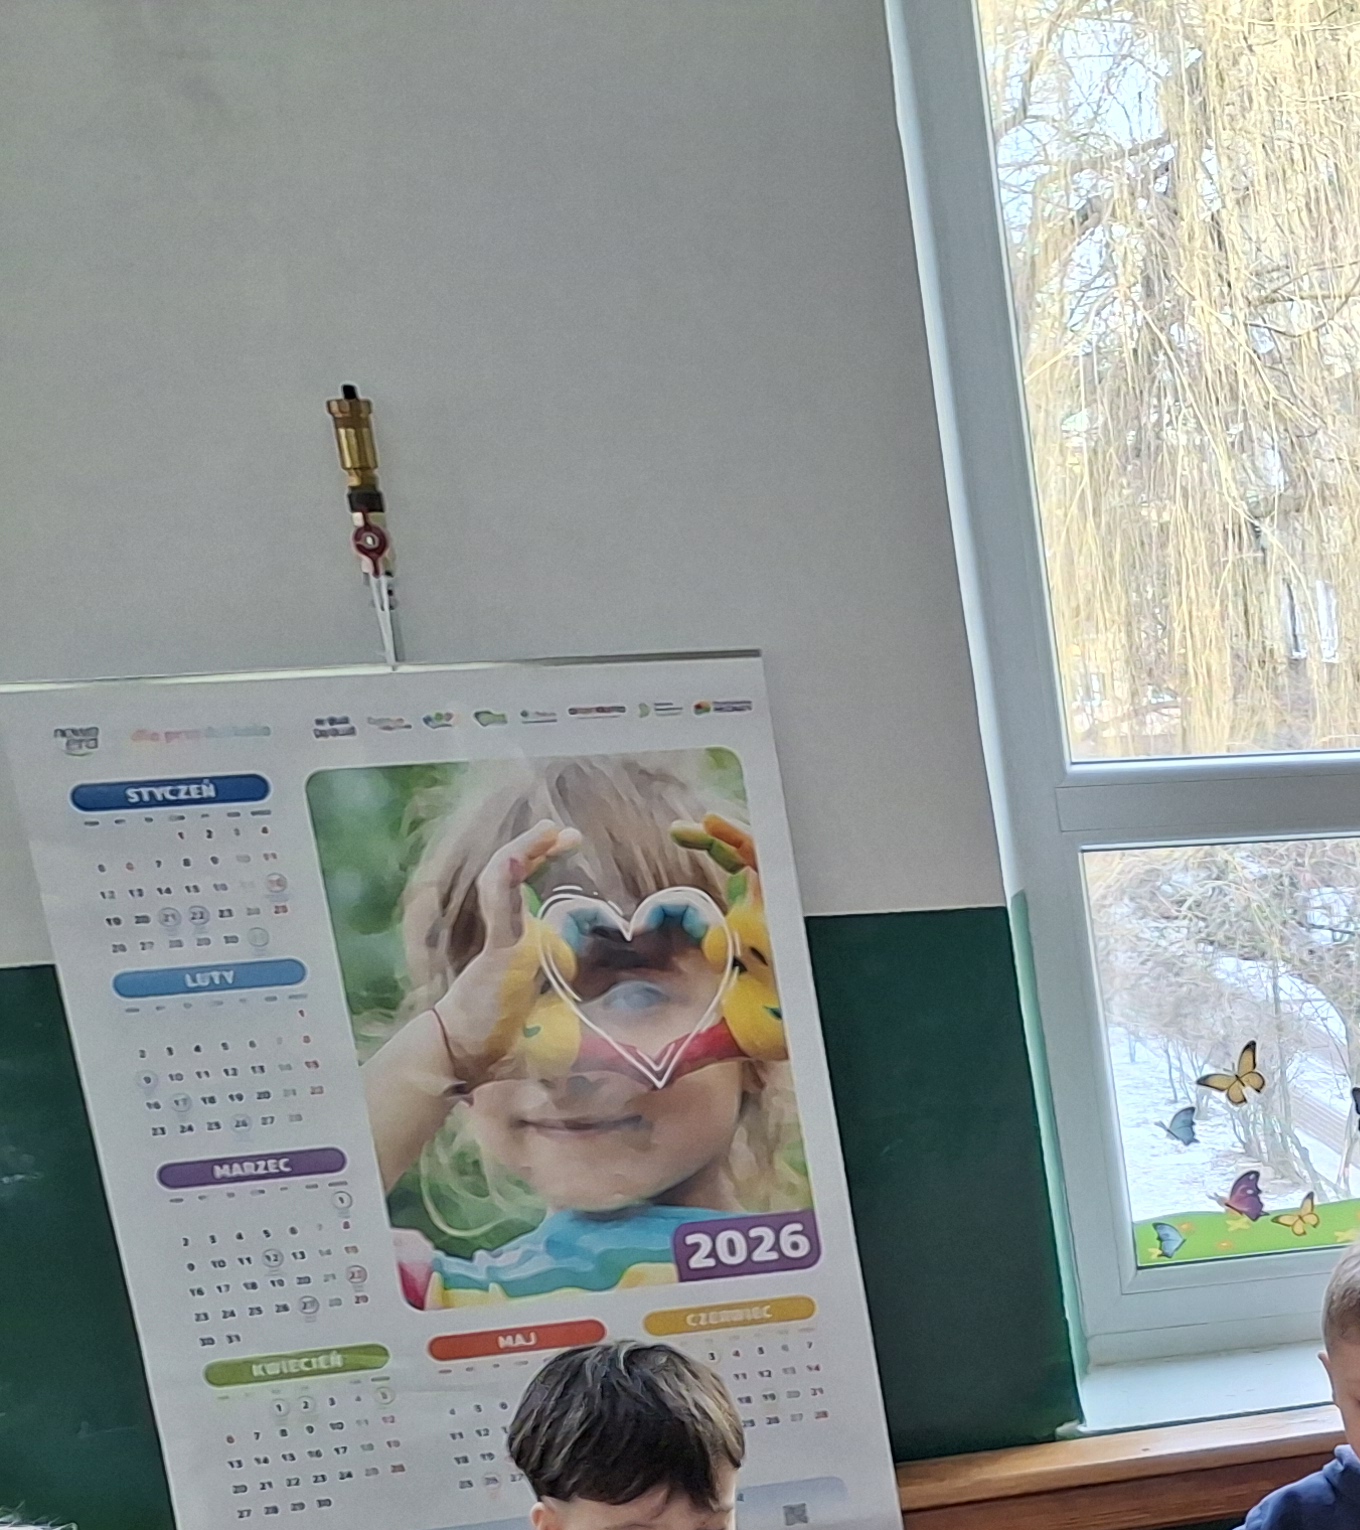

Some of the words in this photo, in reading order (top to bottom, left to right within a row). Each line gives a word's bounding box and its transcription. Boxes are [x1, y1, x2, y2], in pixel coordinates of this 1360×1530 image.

[125, 778, 216, 804] STYCZEŃ
[184, 970, 236, 988] LUTY
[212, 1158, 293, 1180] MARZEC
[684, 1222, 811, 1270] 2026
[497, 1331, 537, 1349] MAJ
